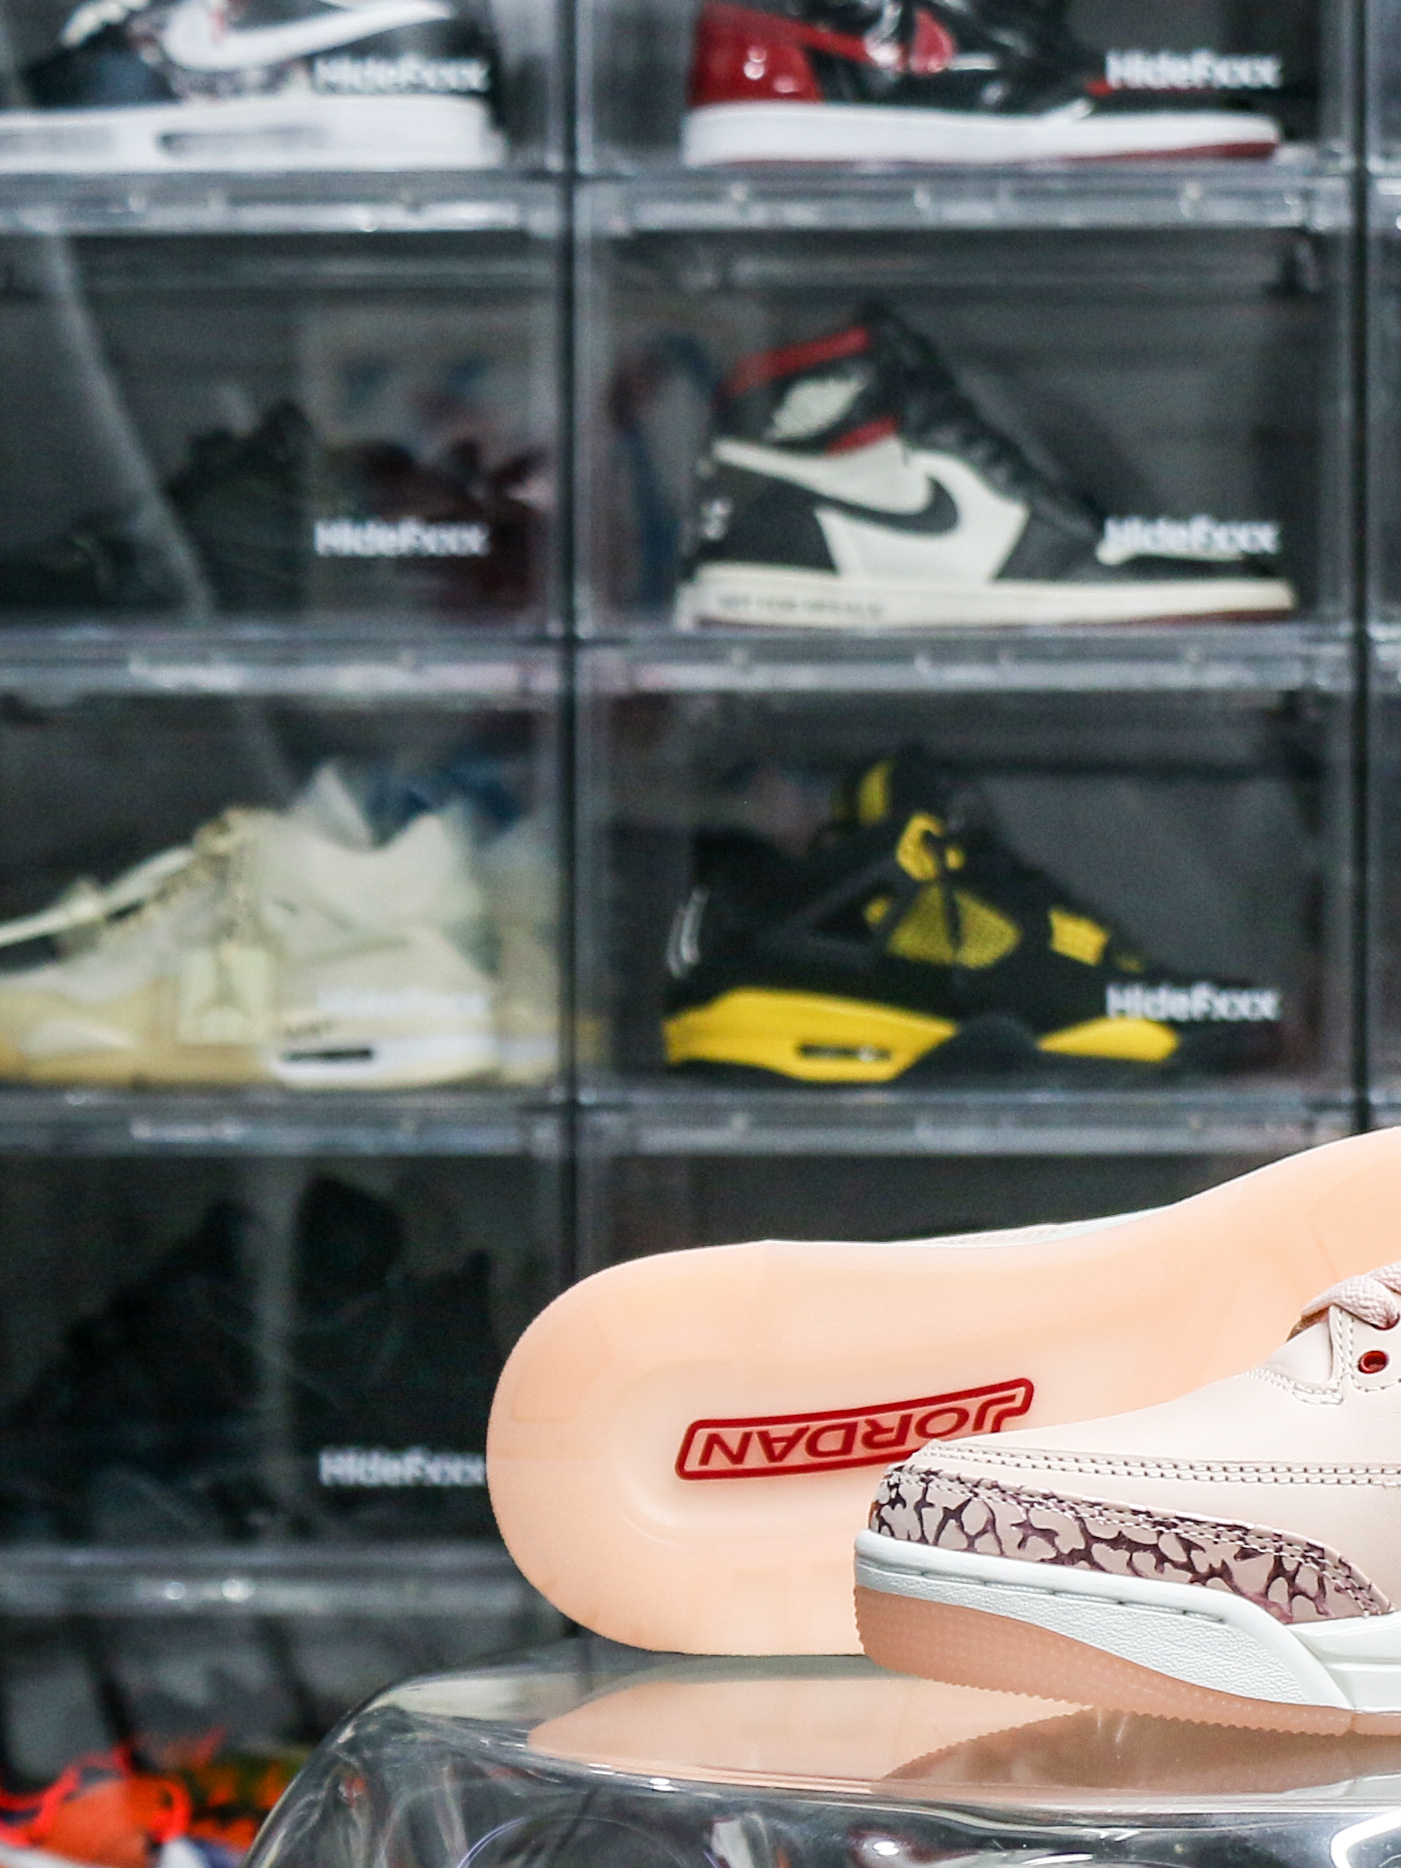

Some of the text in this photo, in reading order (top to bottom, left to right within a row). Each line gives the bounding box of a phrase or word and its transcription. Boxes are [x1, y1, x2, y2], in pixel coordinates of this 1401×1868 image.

[1105, 50, 1281, 89] HideFxxx
[315, 516, 489, 557] HideFxxx
[1105, 516, 1281, 555] HideFxxx
[1106, 983, 1280, 1021] HideFxxx
[698, 1393, 1018, 1466] JORDAN
[318, 1446, 485, 1487] HideFxxx
